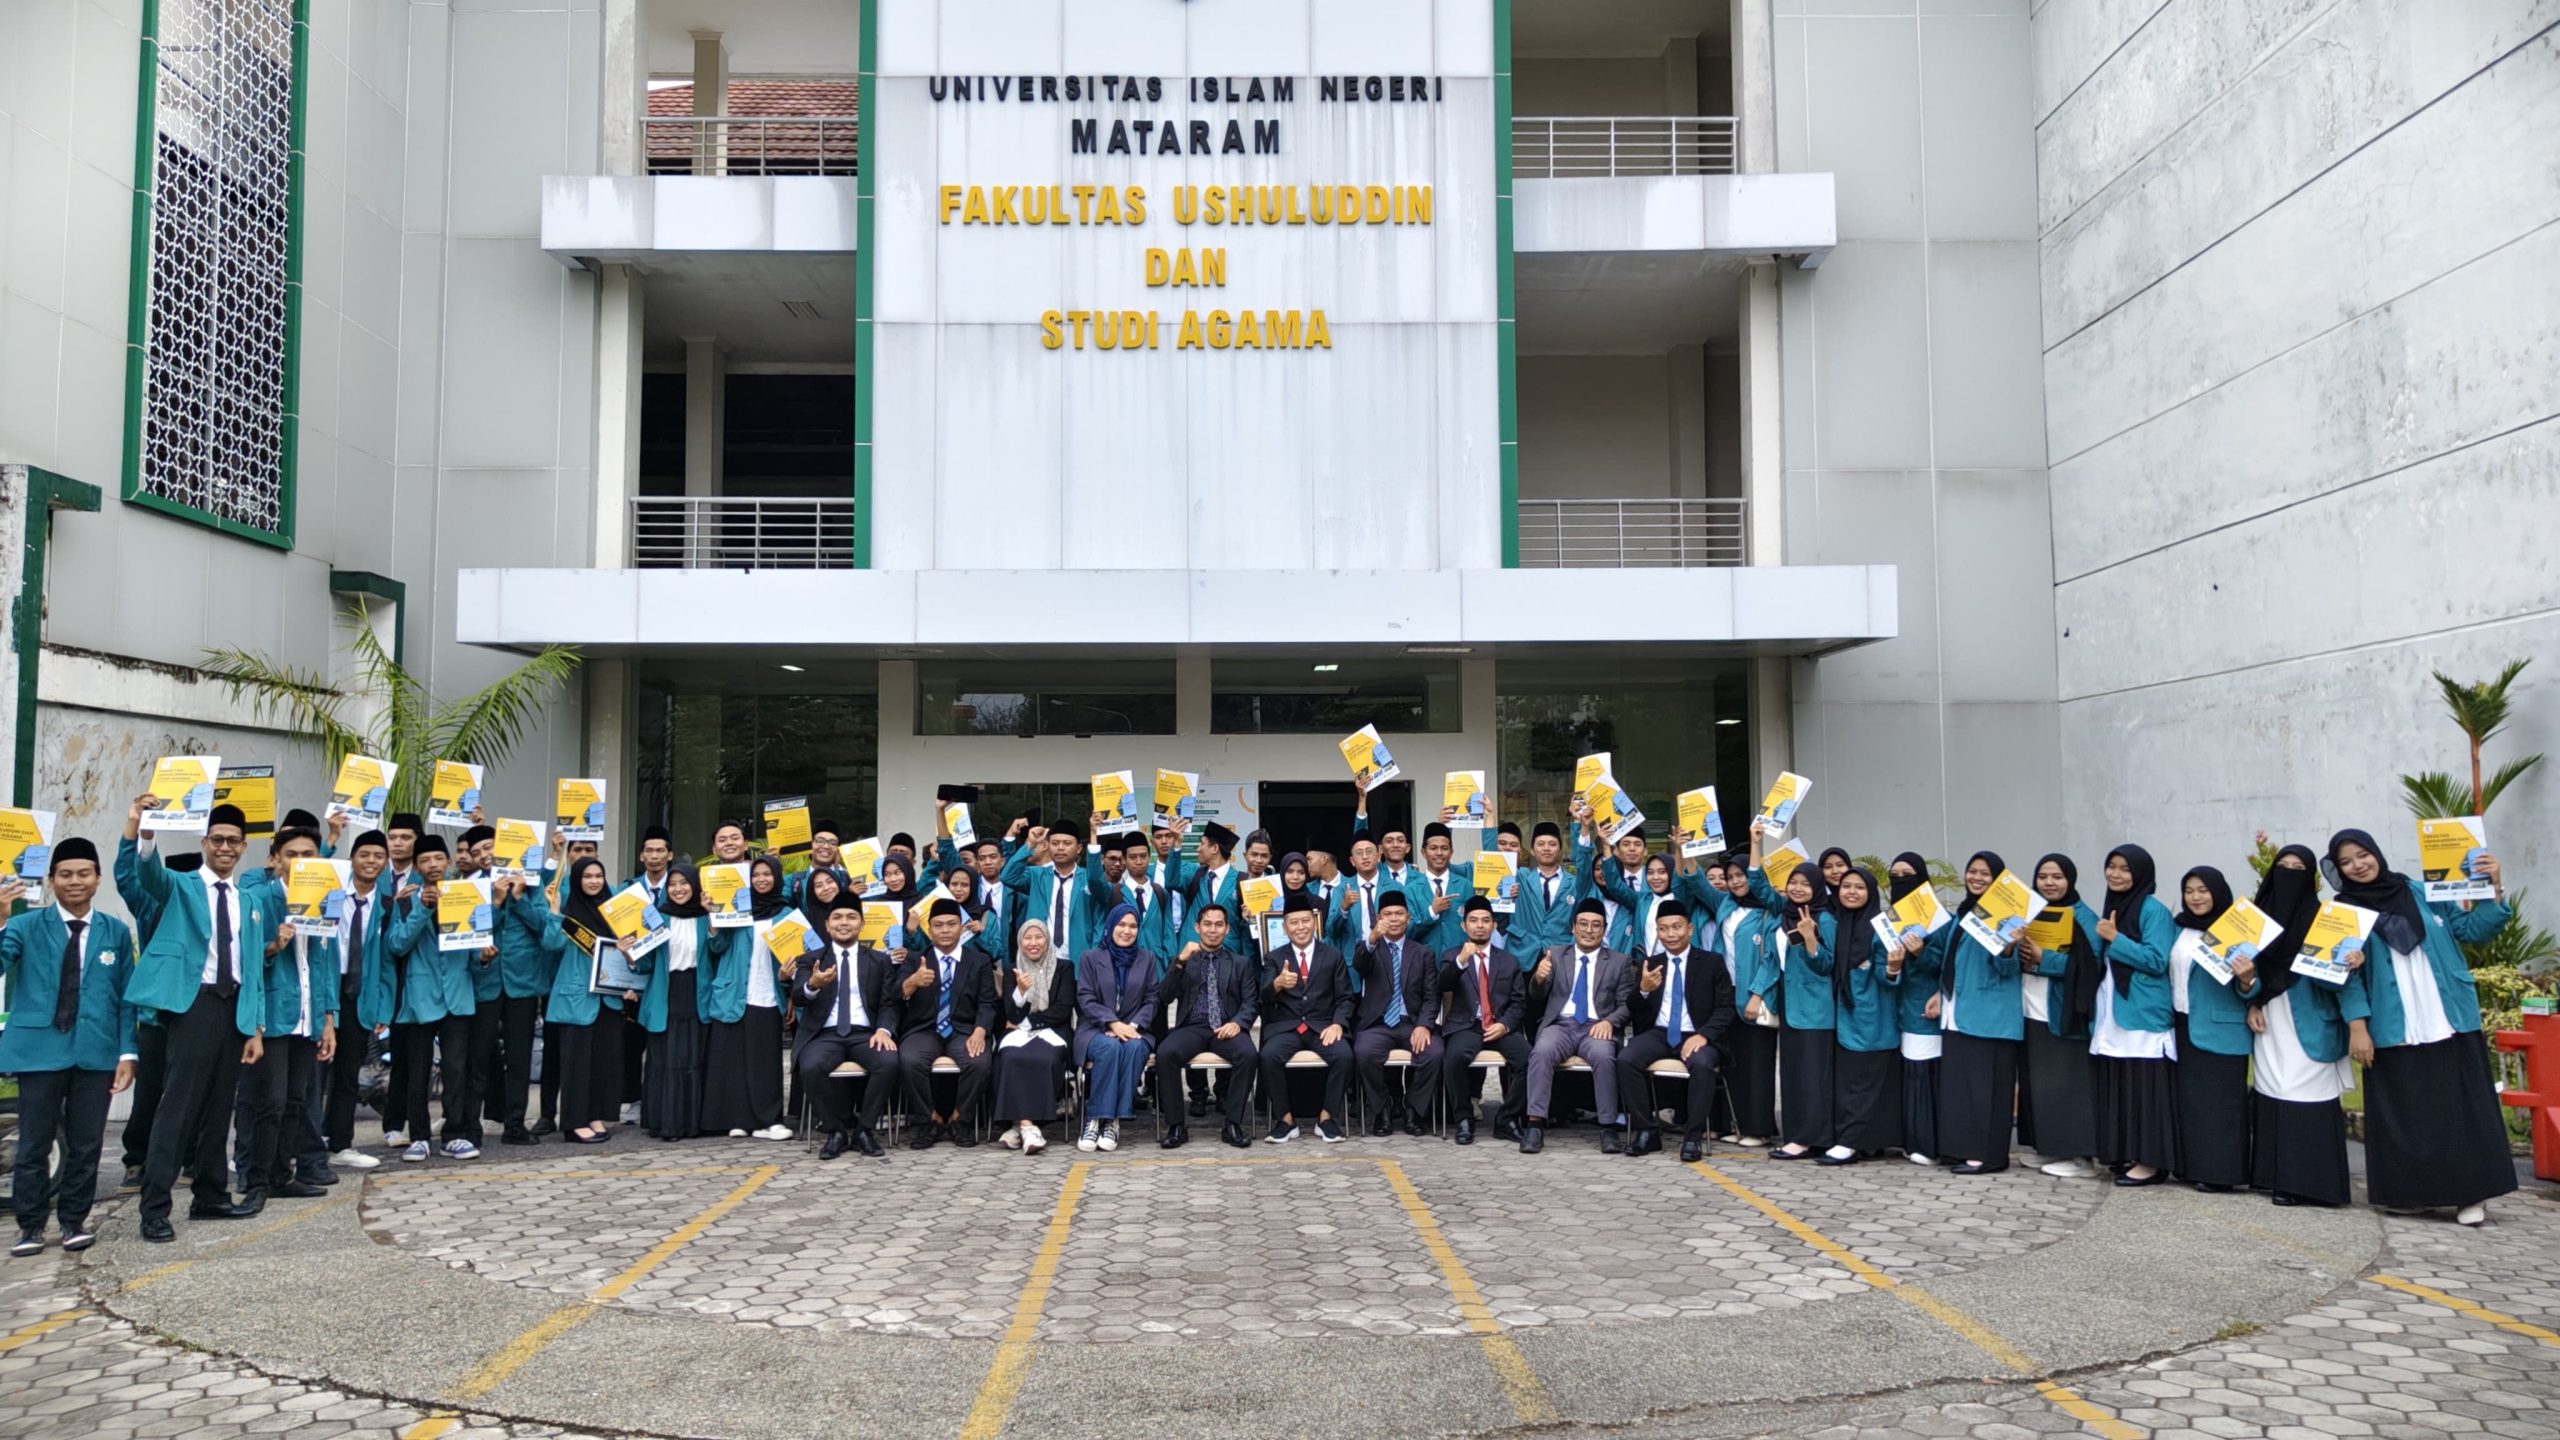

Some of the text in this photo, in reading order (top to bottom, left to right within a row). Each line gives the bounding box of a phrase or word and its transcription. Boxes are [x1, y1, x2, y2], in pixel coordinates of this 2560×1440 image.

[930, 76, 1442, 103] UNIVERSITAS ISLAM NEGERI
[1073, 119, 1279, 155] MATARAM
[941, 186, 1432, 225] FAKULTAS USHULUDDIN
[1146, 249, 1226, 287] DAN
[1042, 310, 1331, 350] STUDI AGAMA
